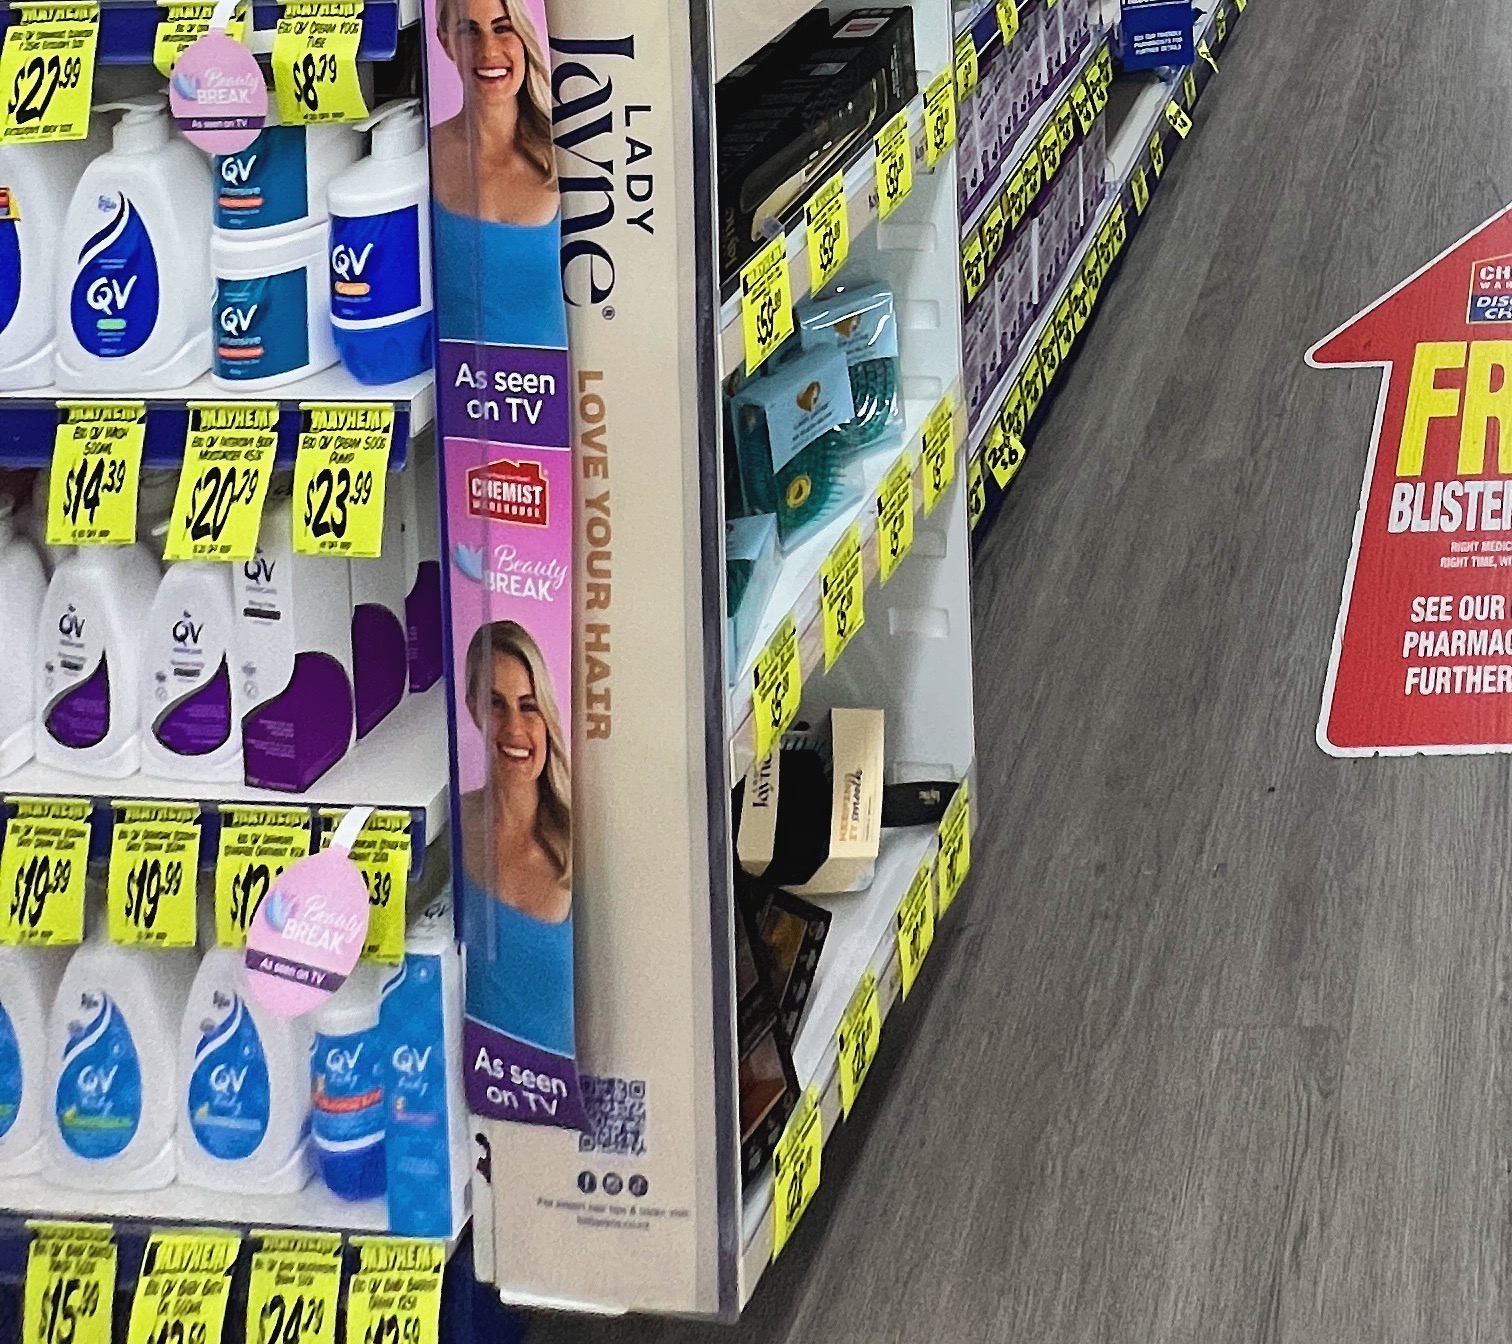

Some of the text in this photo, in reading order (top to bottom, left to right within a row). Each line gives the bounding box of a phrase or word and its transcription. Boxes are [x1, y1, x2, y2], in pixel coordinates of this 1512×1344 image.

[624, 105, 655, 235] LADY
[87, 276, 137, 315] QV
[577, 370, 609, 479] LOVE
[580, 489, 612, 608] YOUR
[1440, 556, 1469, 569] RIGHT
[1450, 541, 1479, 553] RIGHT
[1411, 596, 1453, 623] SEE
[1459, 594, 1505, 620] OUR
[580, 620, 612, 741] HAIR
